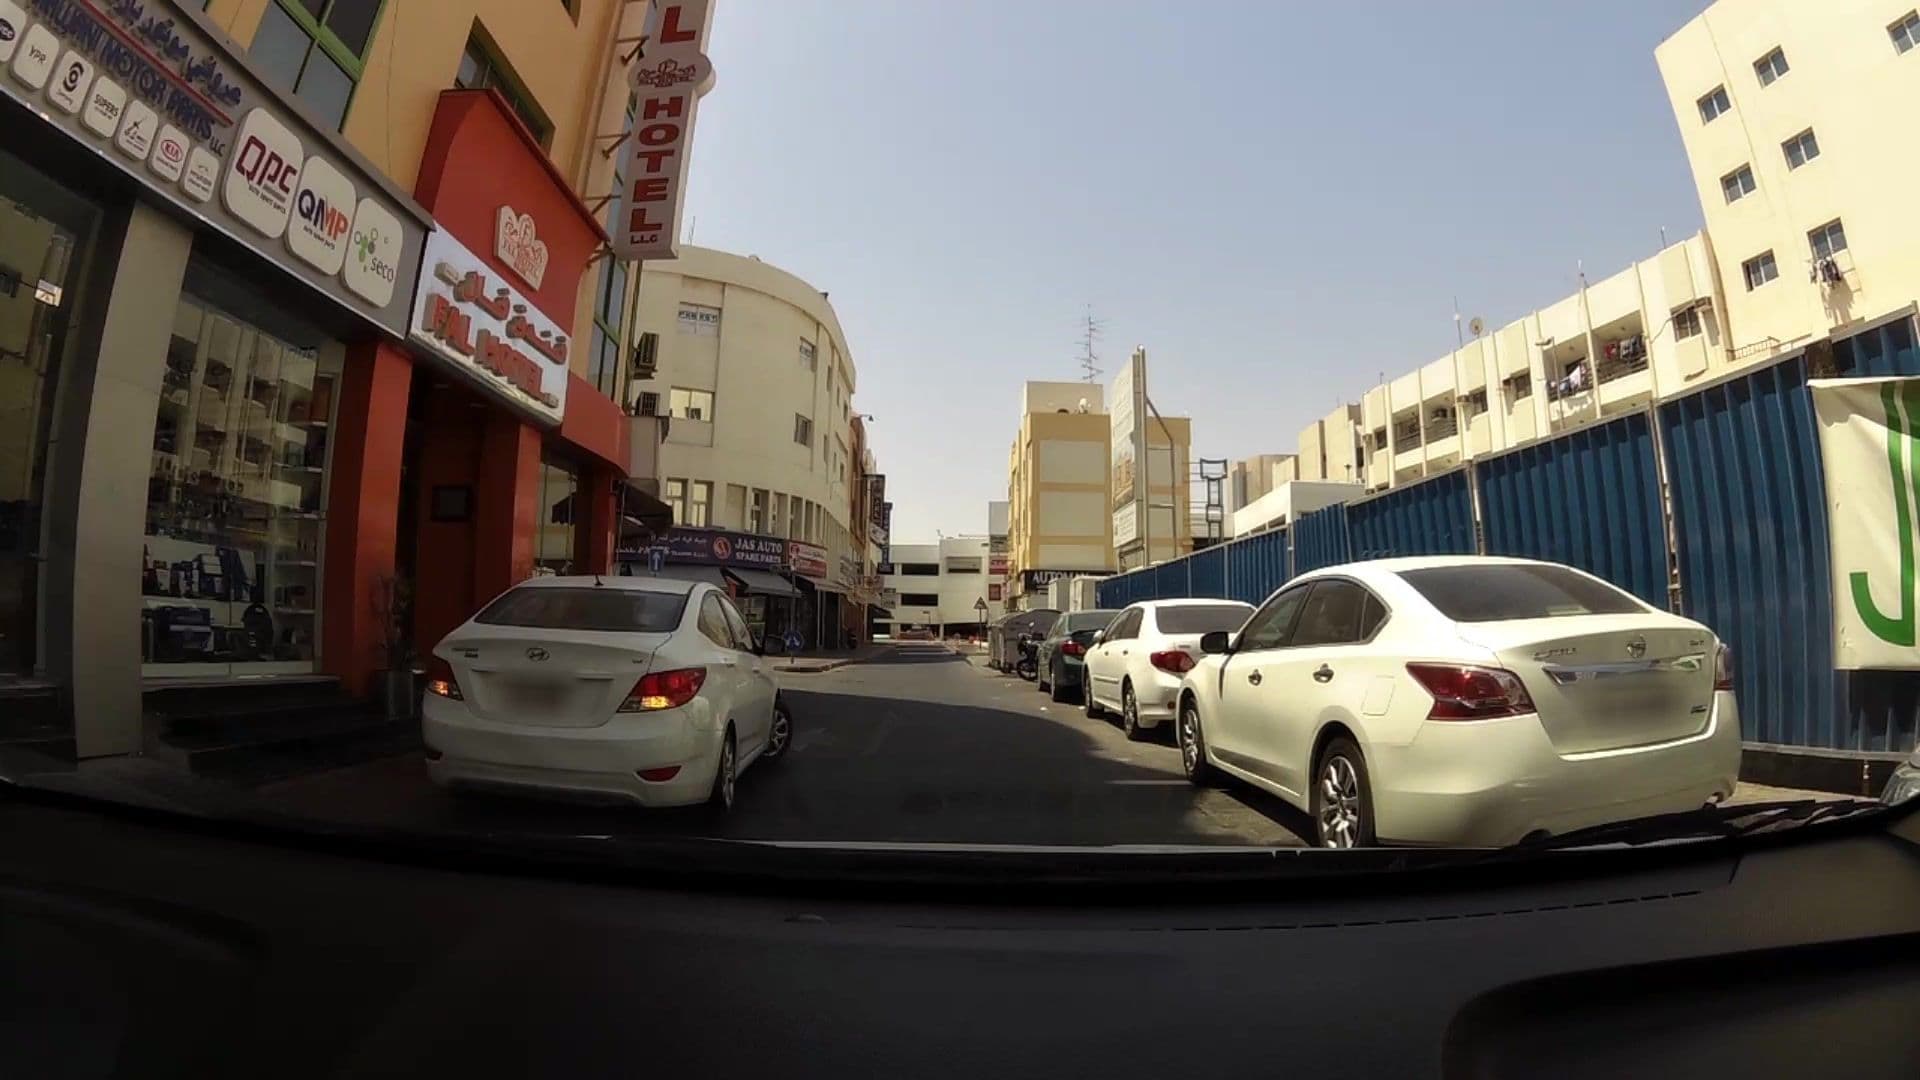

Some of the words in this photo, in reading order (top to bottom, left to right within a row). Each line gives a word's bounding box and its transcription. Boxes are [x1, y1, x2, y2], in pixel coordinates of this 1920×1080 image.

[629, 96, 684, 232] HOTEL
[630, 234, 659, 245] LLC
[369, 256, 395, 284] seco
[473, 328, 545, 401] HOTEL
[734, 538, 756, 551] JAS
[757, 540, 783, 553] AUTO
